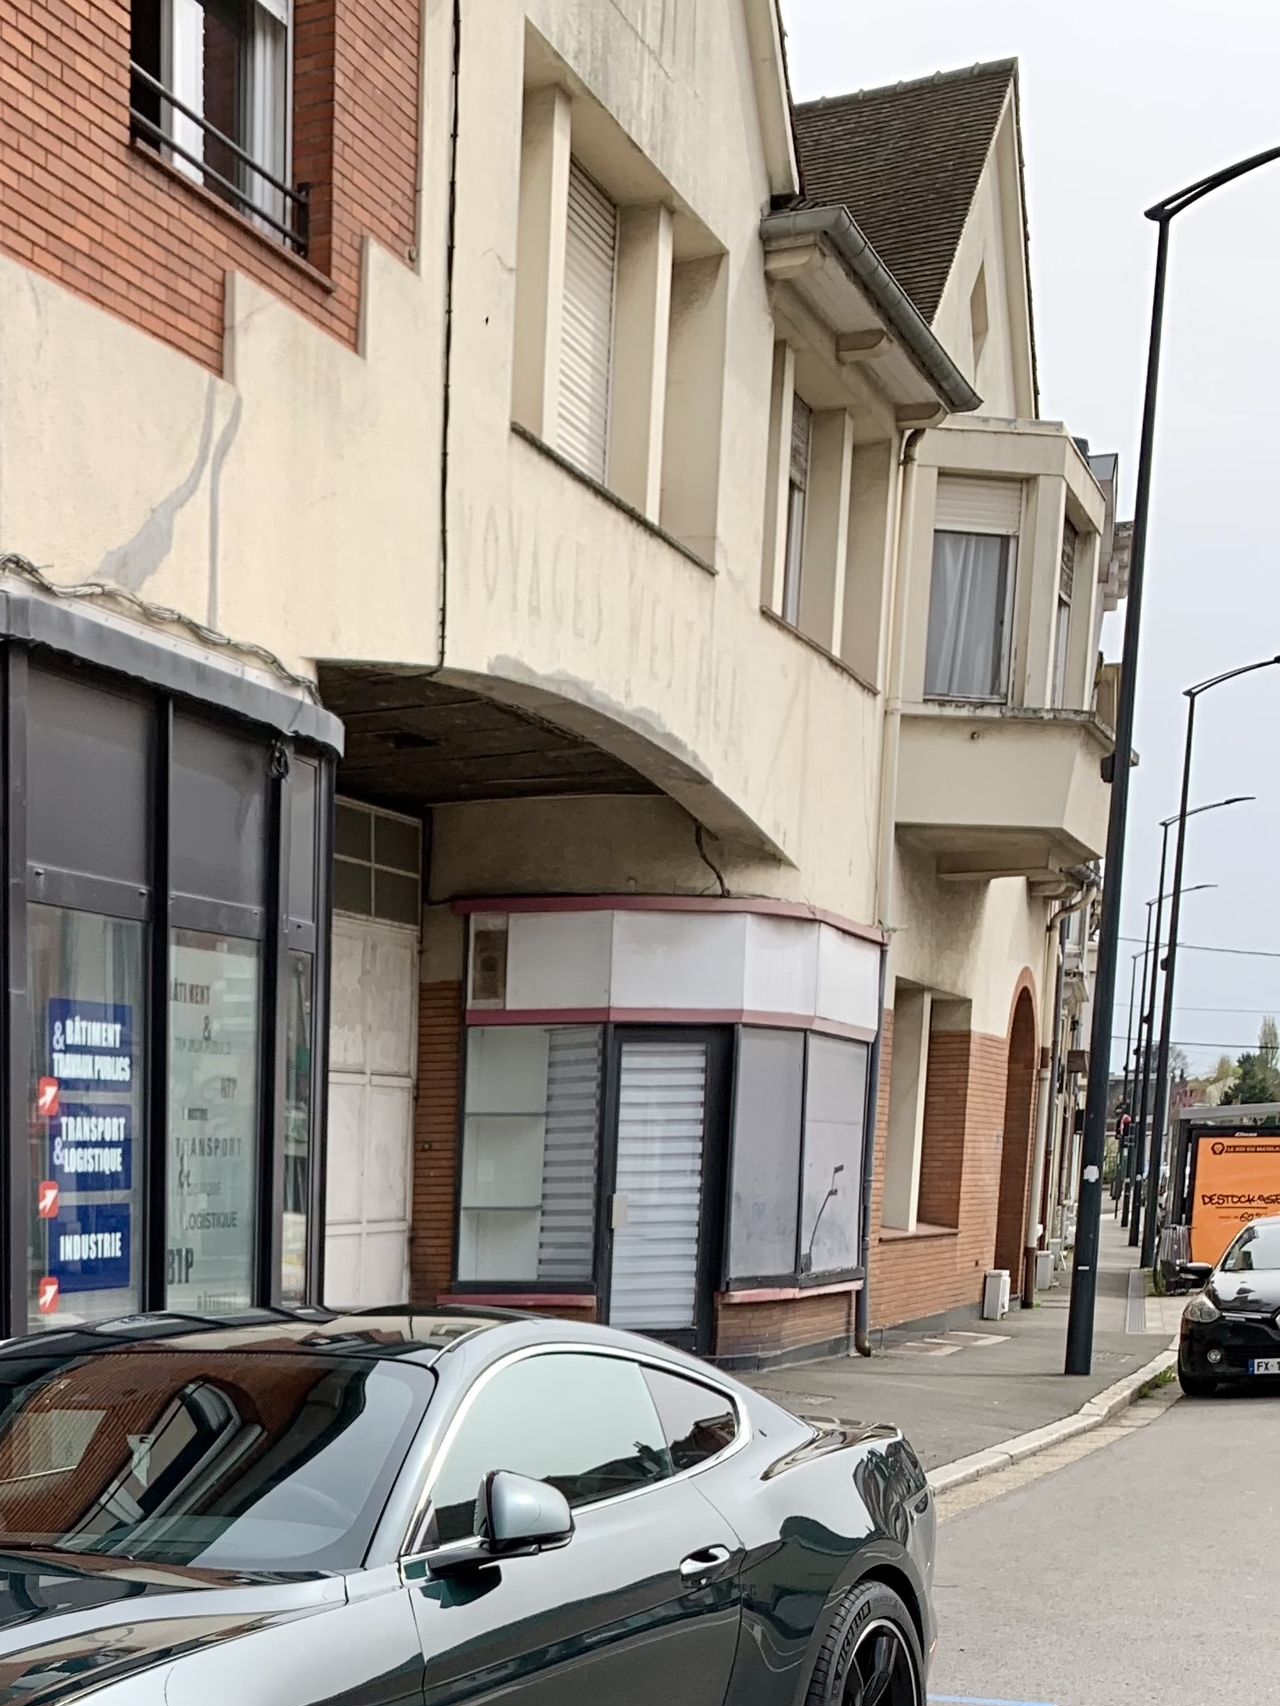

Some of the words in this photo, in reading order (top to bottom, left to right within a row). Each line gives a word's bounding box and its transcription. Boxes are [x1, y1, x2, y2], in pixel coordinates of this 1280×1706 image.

[65, 1014, 122, 1049] BÂTIMENT
[61, 1116, 126, 1142] TRANSPORT
[64, 1147, 122, 1175] LOGISTIQUE
[60, 1232, 121, 1261] INDUSTRIE
